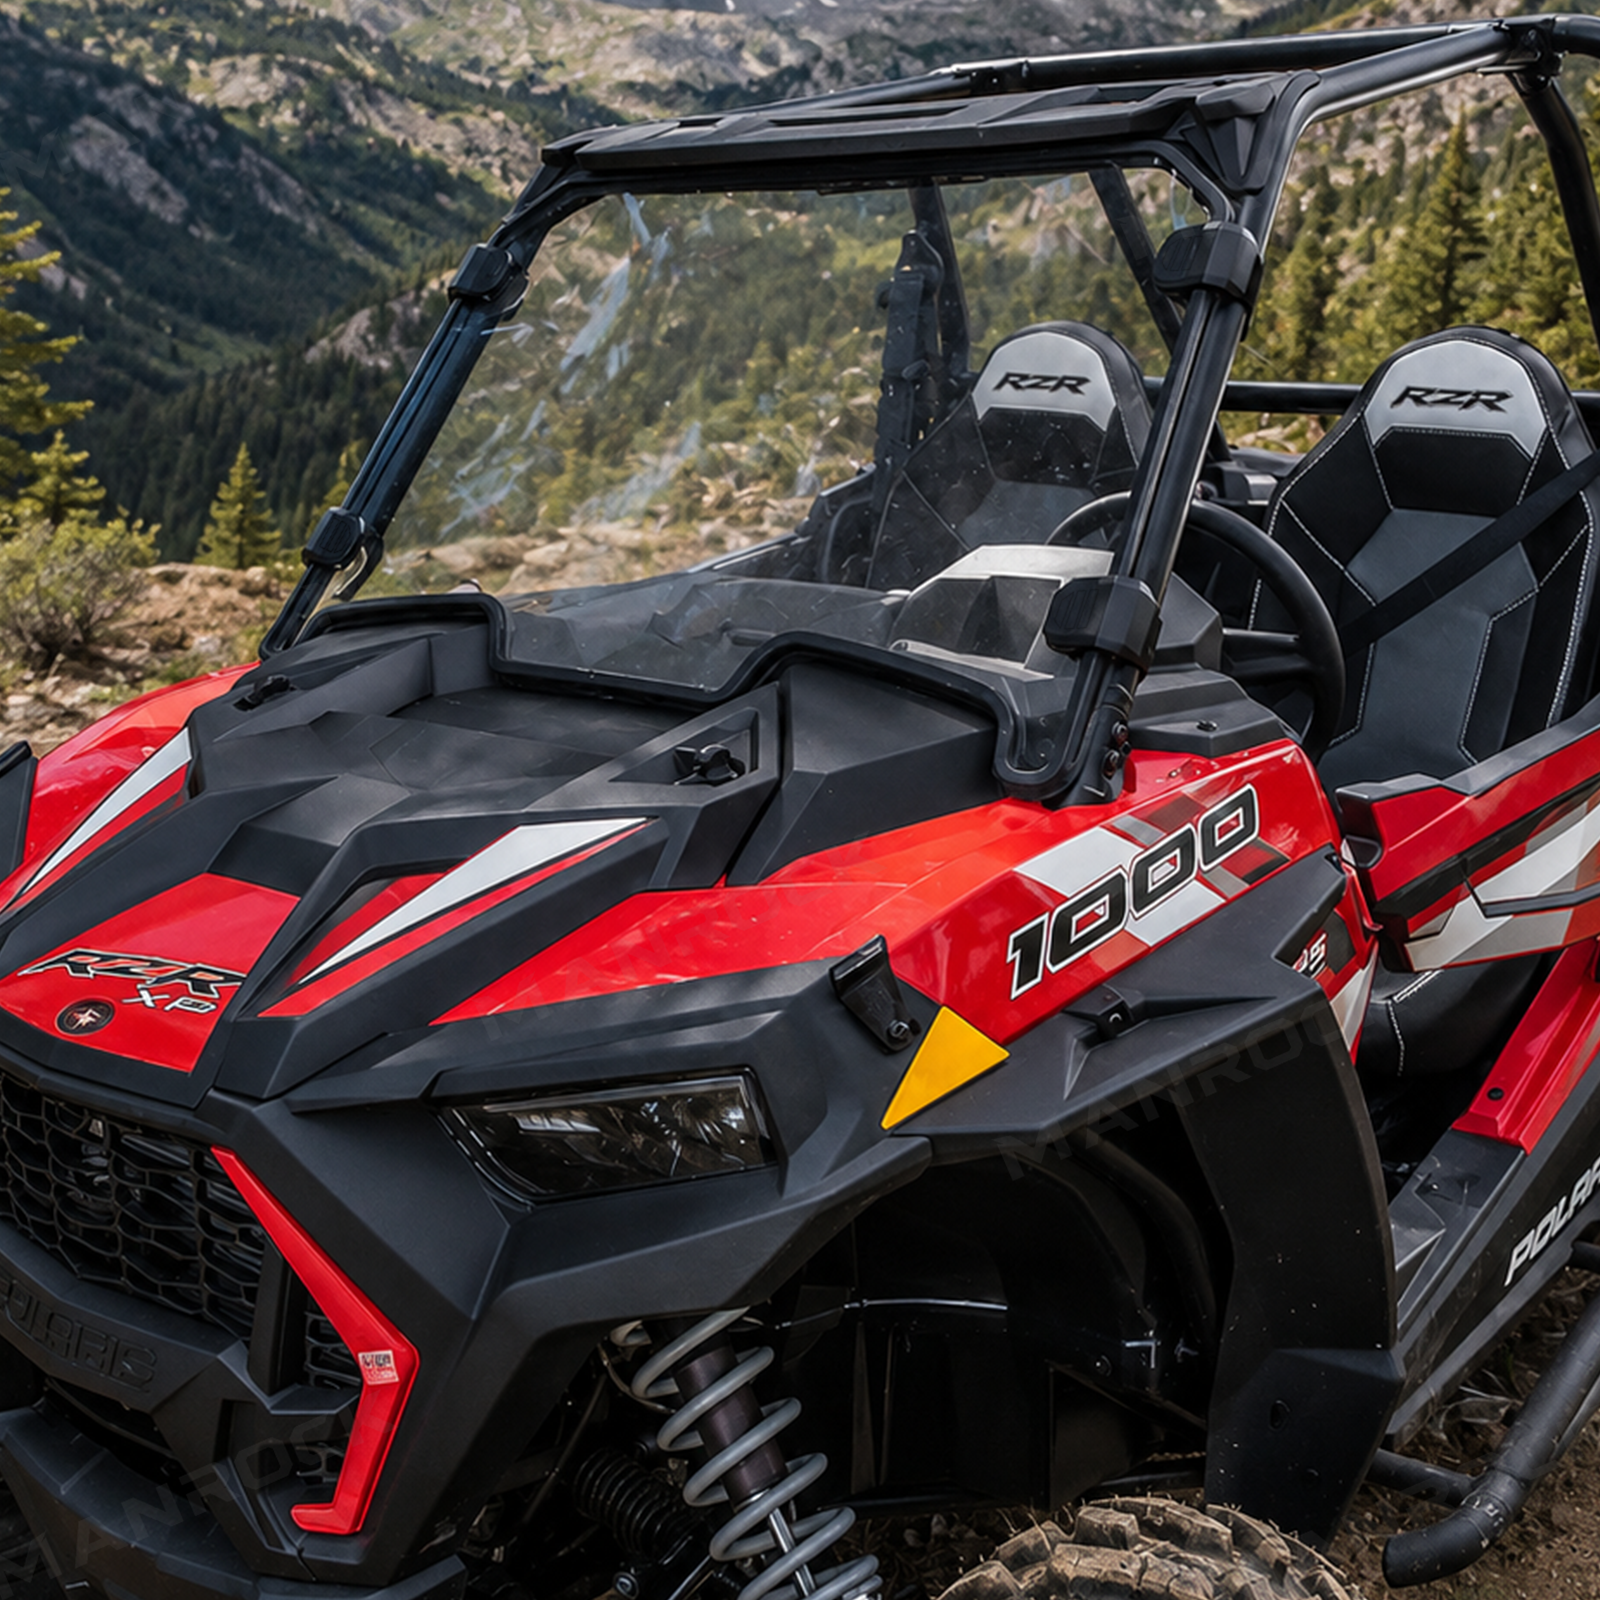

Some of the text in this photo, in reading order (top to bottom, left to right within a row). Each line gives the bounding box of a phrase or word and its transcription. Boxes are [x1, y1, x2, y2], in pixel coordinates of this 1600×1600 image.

[992, 371, 1091, 396] RZR
[1390, 385, 1514, 414] RZR
[1006, 783, 1259, 1000] 1000
[17, 948, 247, 998] RZR
[122, 983, 217, 1014] XP
